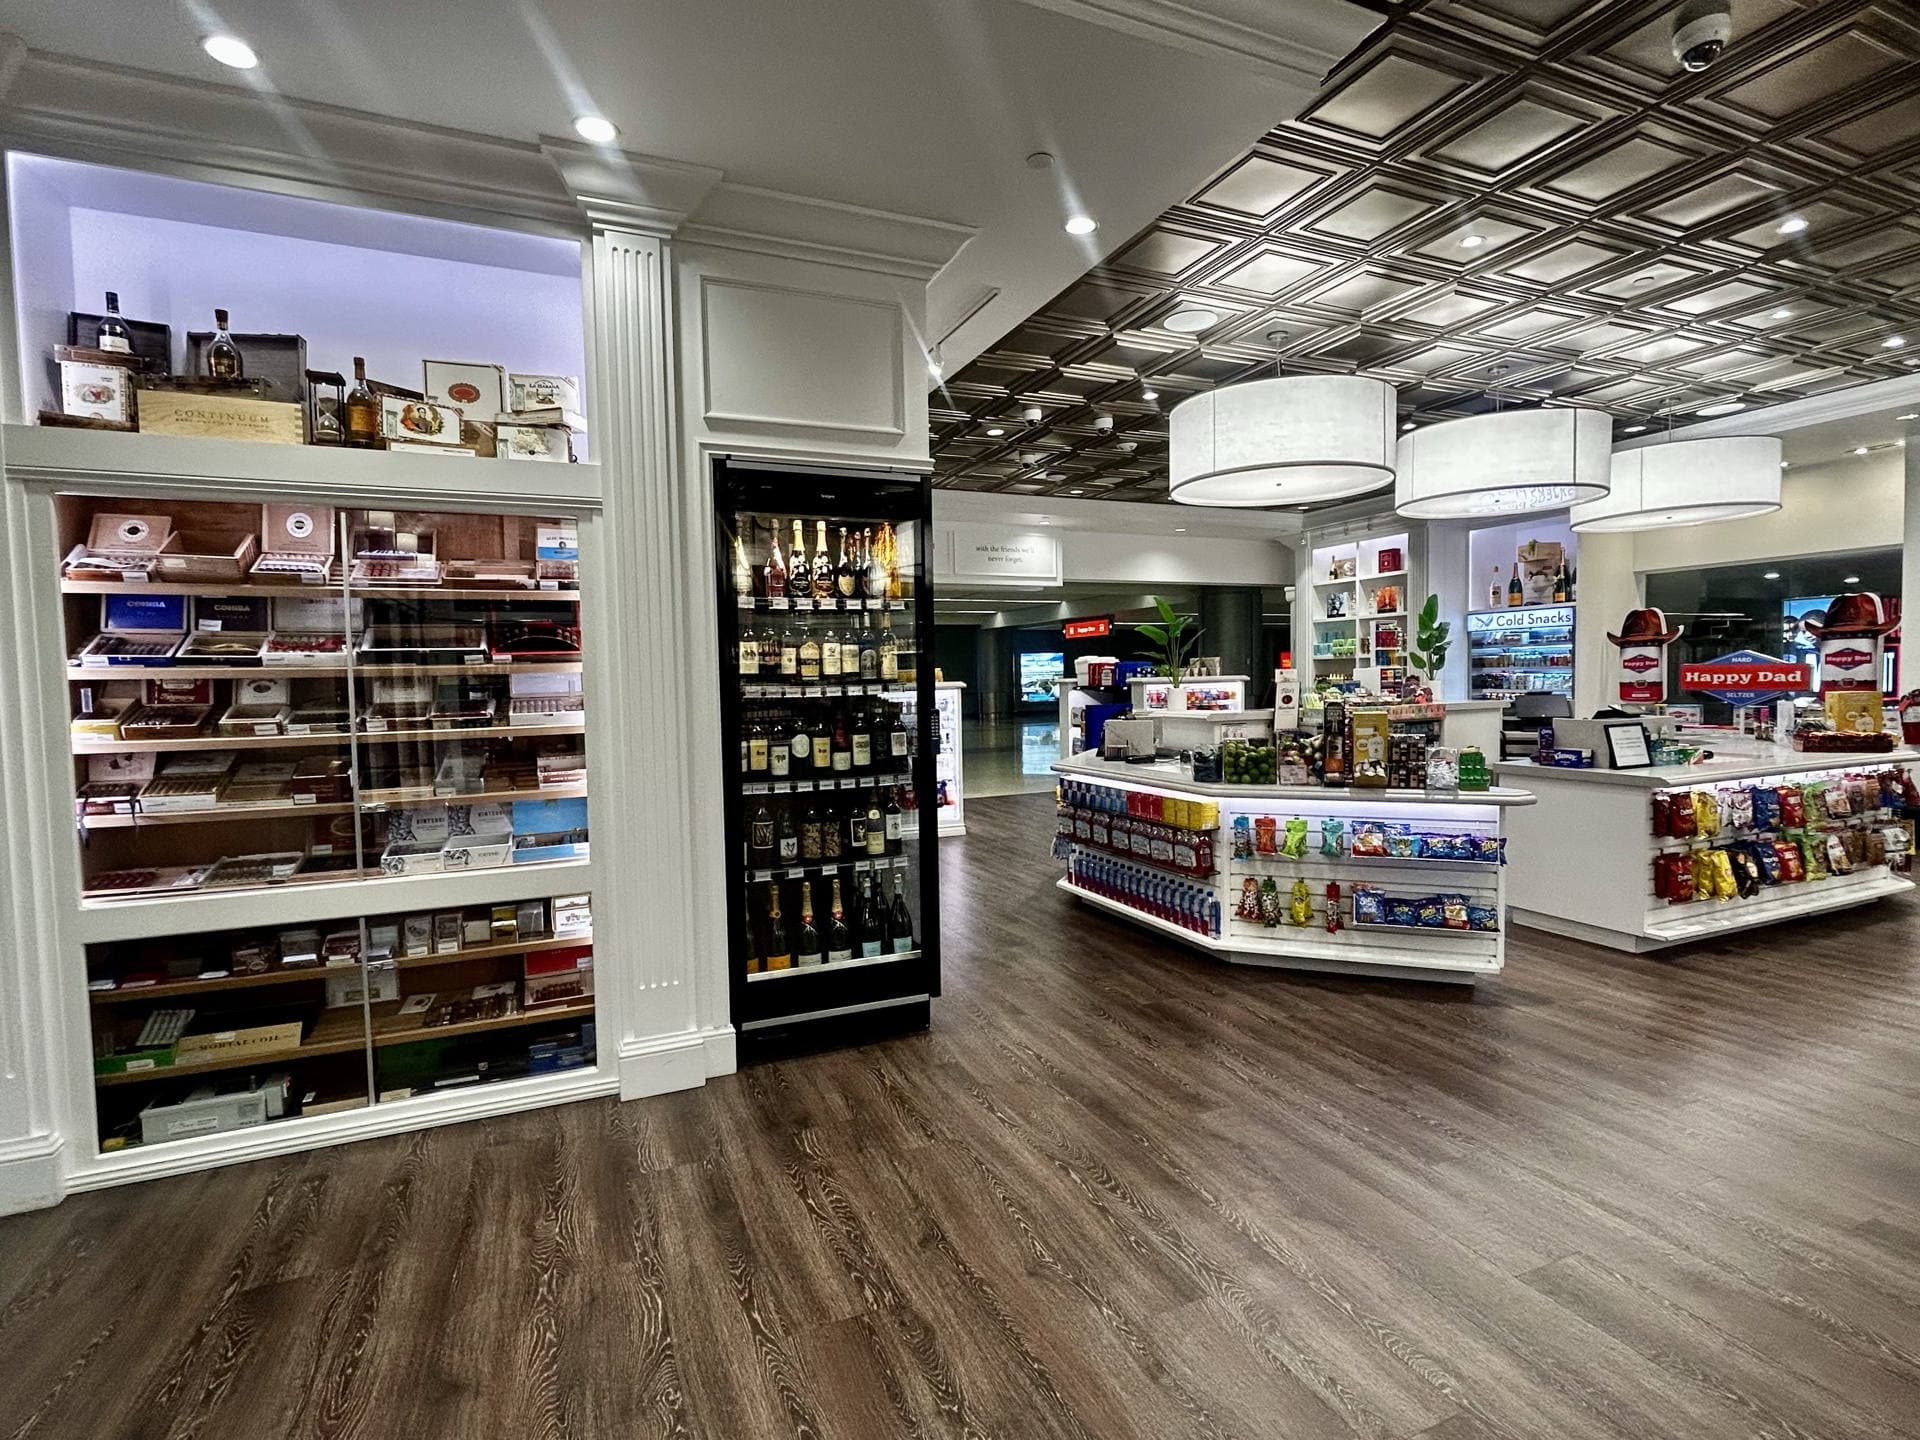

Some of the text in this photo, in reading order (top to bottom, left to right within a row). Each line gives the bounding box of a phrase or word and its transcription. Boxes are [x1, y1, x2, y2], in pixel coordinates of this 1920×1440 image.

[174, 408, 270, 422] CONTINUUM
[990, 544, 999, 552] the
[1496, 611, 1571, 627] Cold Snacks
[1685, 671, 1803, 685] Happy Dad
